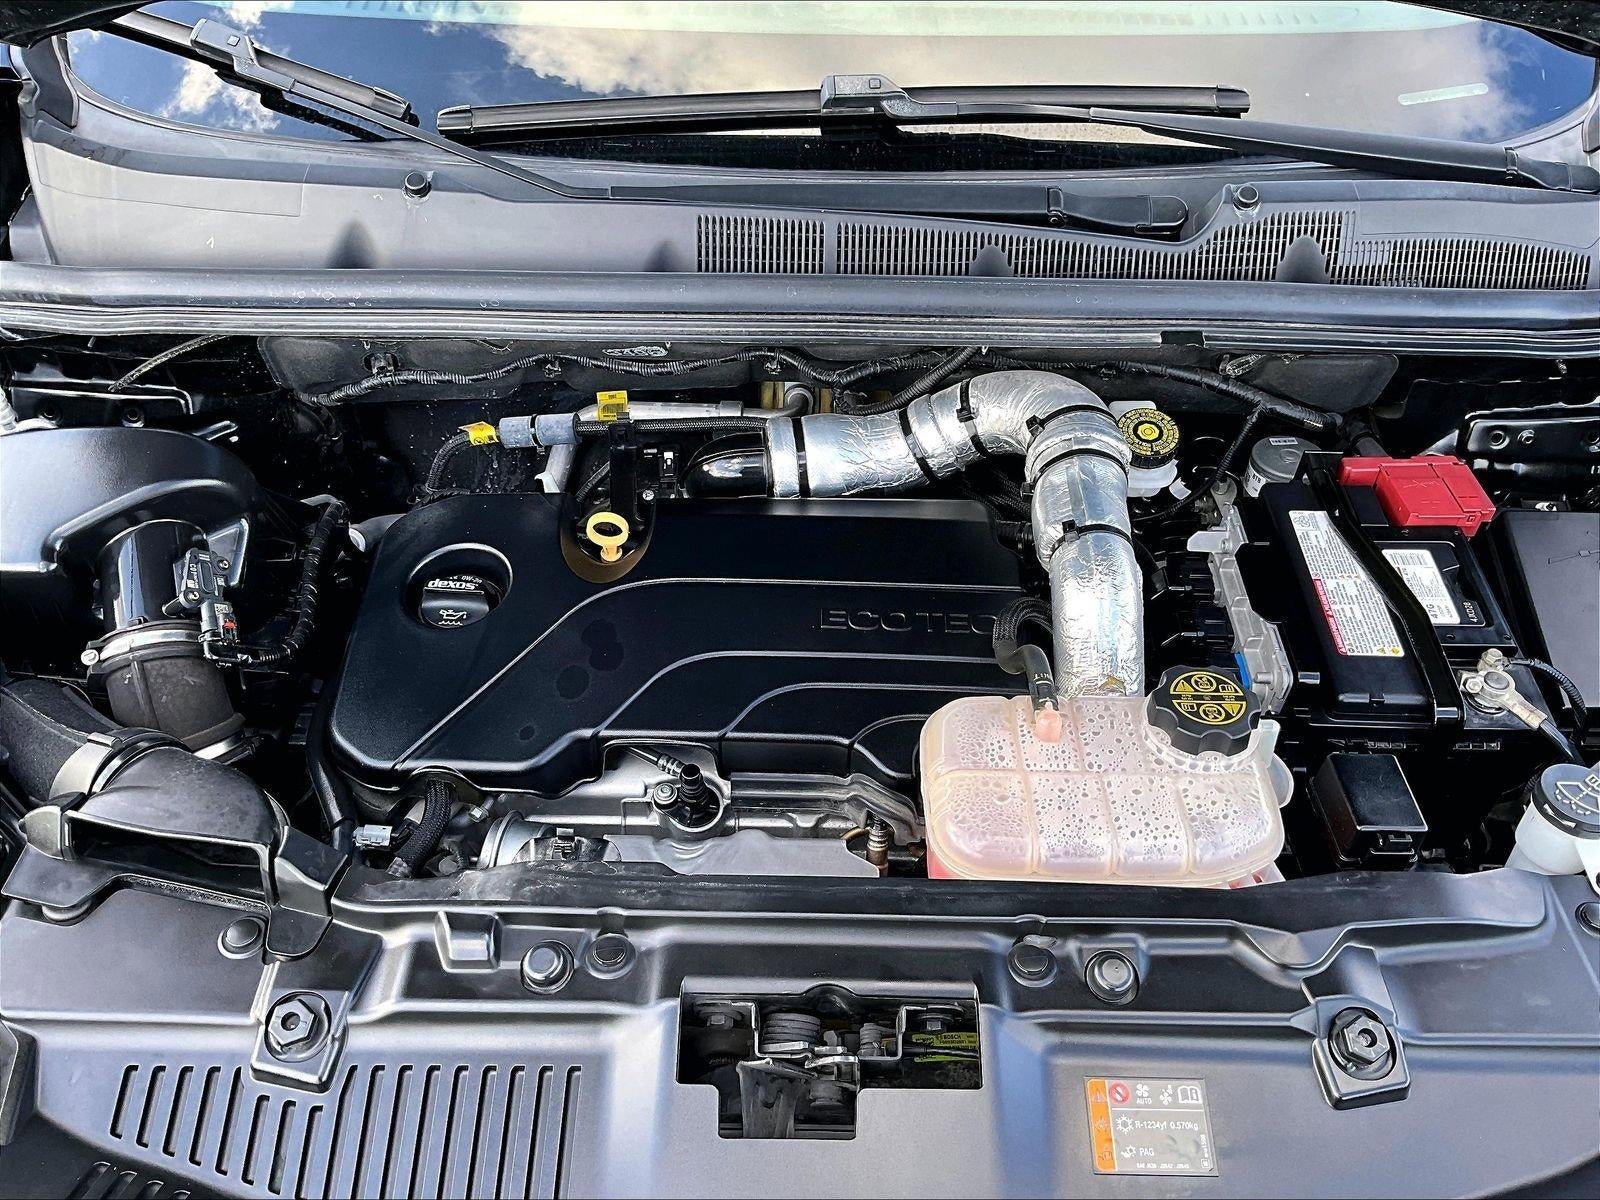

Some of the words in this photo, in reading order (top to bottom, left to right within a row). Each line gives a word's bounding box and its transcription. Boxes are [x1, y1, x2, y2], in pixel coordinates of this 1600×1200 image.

[427, 578, 476, 590] dexos
[820, 609, 998, 635] ECOTEC
[1136, 1097, 1153, 1105] AUTO
[1169, 1120, 1199, 1131] 0.570kg
[1139, 1147, 1155, 1157] PAG
